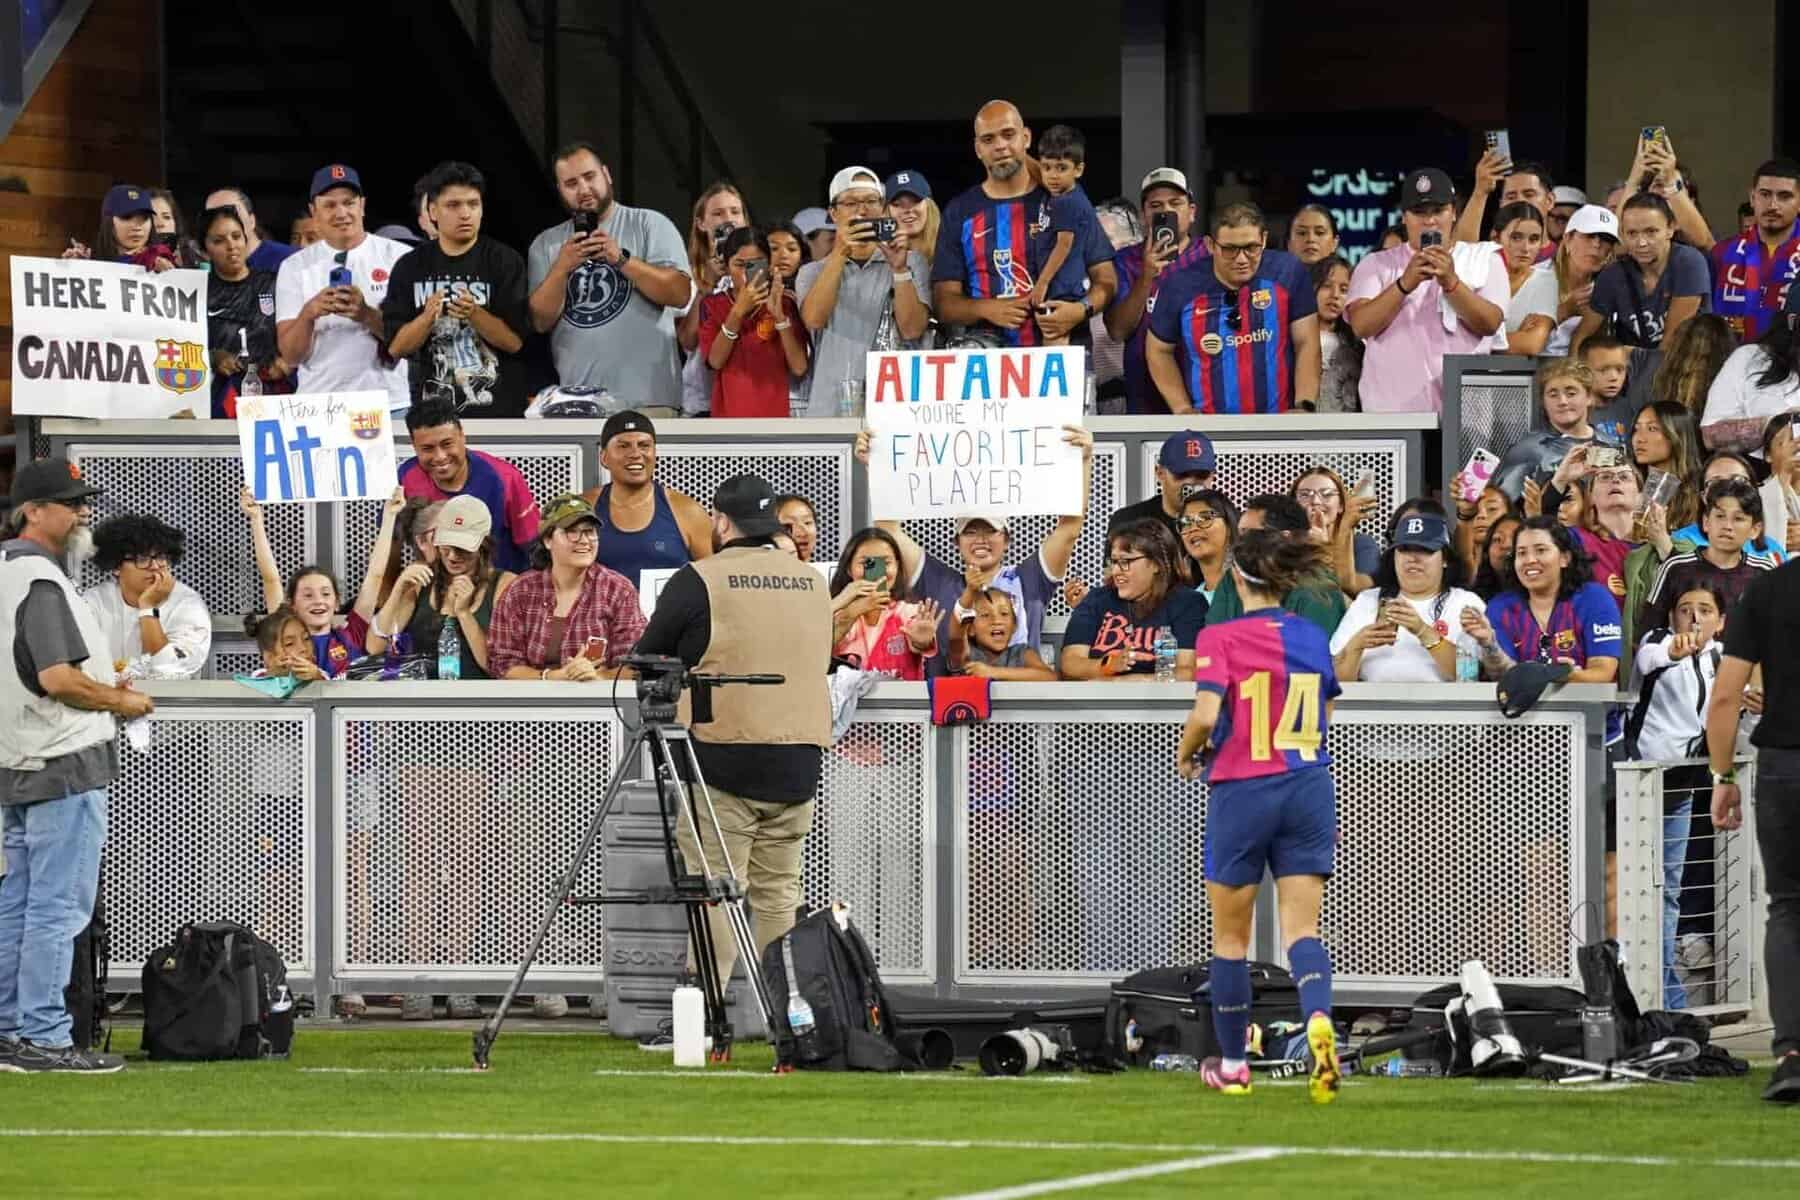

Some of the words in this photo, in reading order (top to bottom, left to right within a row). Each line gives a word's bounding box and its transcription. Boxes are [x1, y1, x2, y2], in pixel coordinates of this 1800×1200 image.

[24, 272, 106, 309] HERE
[120, 278, 198, 323] FROM
[238, 327, 249, 357] 1
[1225, 328, 1273, 347] Spotify
[17, 334, 151, 385] CANADA
[874, 353, 1069, 402] AITANA
[279, 398, 319, 417] Here
[322, 395, 347, 425] for
[983, 402, 1008, 423] MY
[891, 426, 1056, 472] FAVORITE
[908, 469, 1023, 506] PLAYER
[728, 575, 814, 591] BROADCAST
[1239, 671, 1321, 761] 14
[612, 948, 687, 966] SONY
